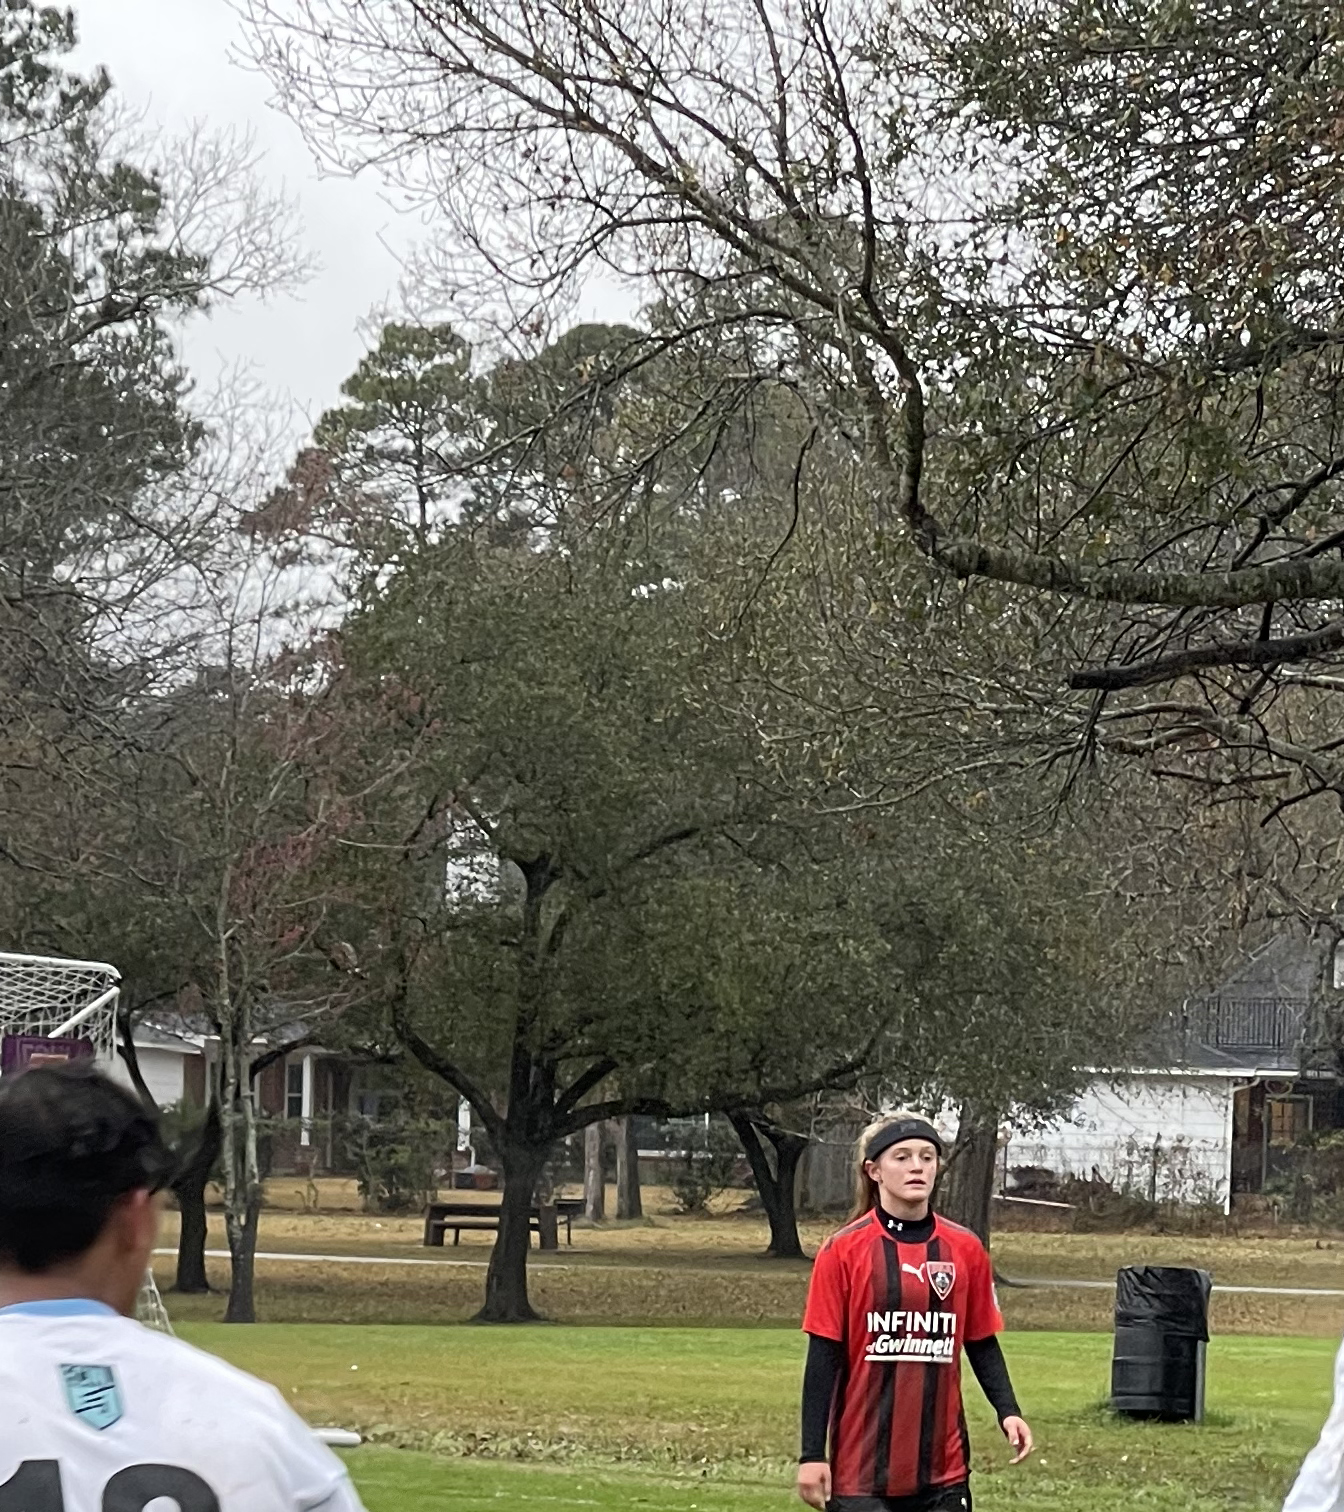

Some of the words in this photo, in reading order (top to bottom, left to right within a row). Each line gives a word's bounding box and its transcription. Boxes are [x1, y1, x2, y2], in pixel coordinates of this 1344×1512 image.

[867, 1311, 956, 1334] INFINITI
[866, 1341, 875, 1353] of
[875, 1333, 955, 1355] Gwinnett
